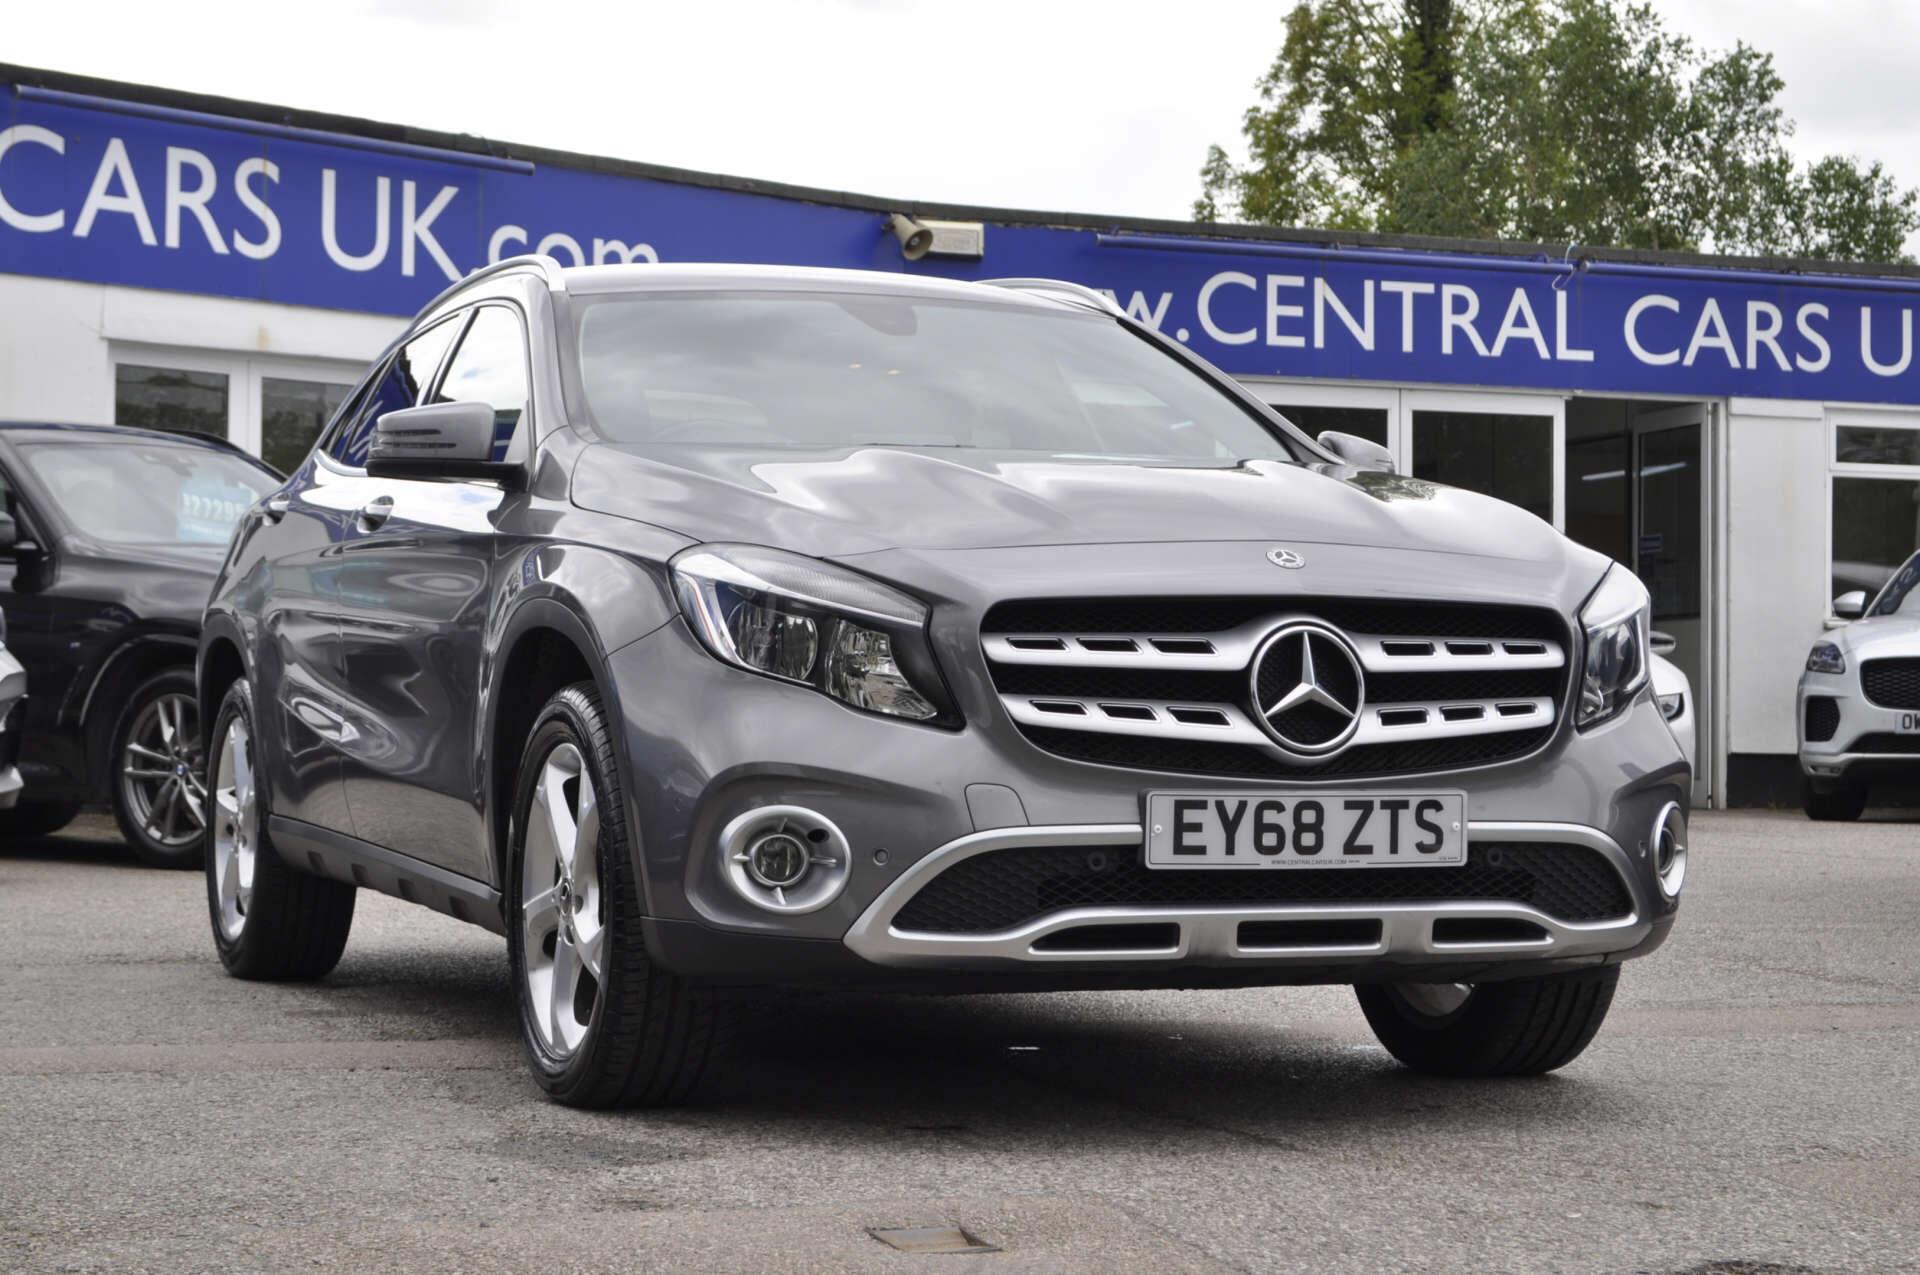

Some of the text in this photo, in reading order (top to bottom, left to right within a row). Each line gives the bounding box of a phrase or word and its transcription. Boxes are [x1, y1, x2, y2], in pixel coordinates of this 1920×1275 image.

[0, 126, 281, 259] CARS
[1093, 271, 1595, 362] w.CENTRAL
[1625, 295, 1831, 372] CARS
[1172, 799, 1444, 856] EY68 ZTS
